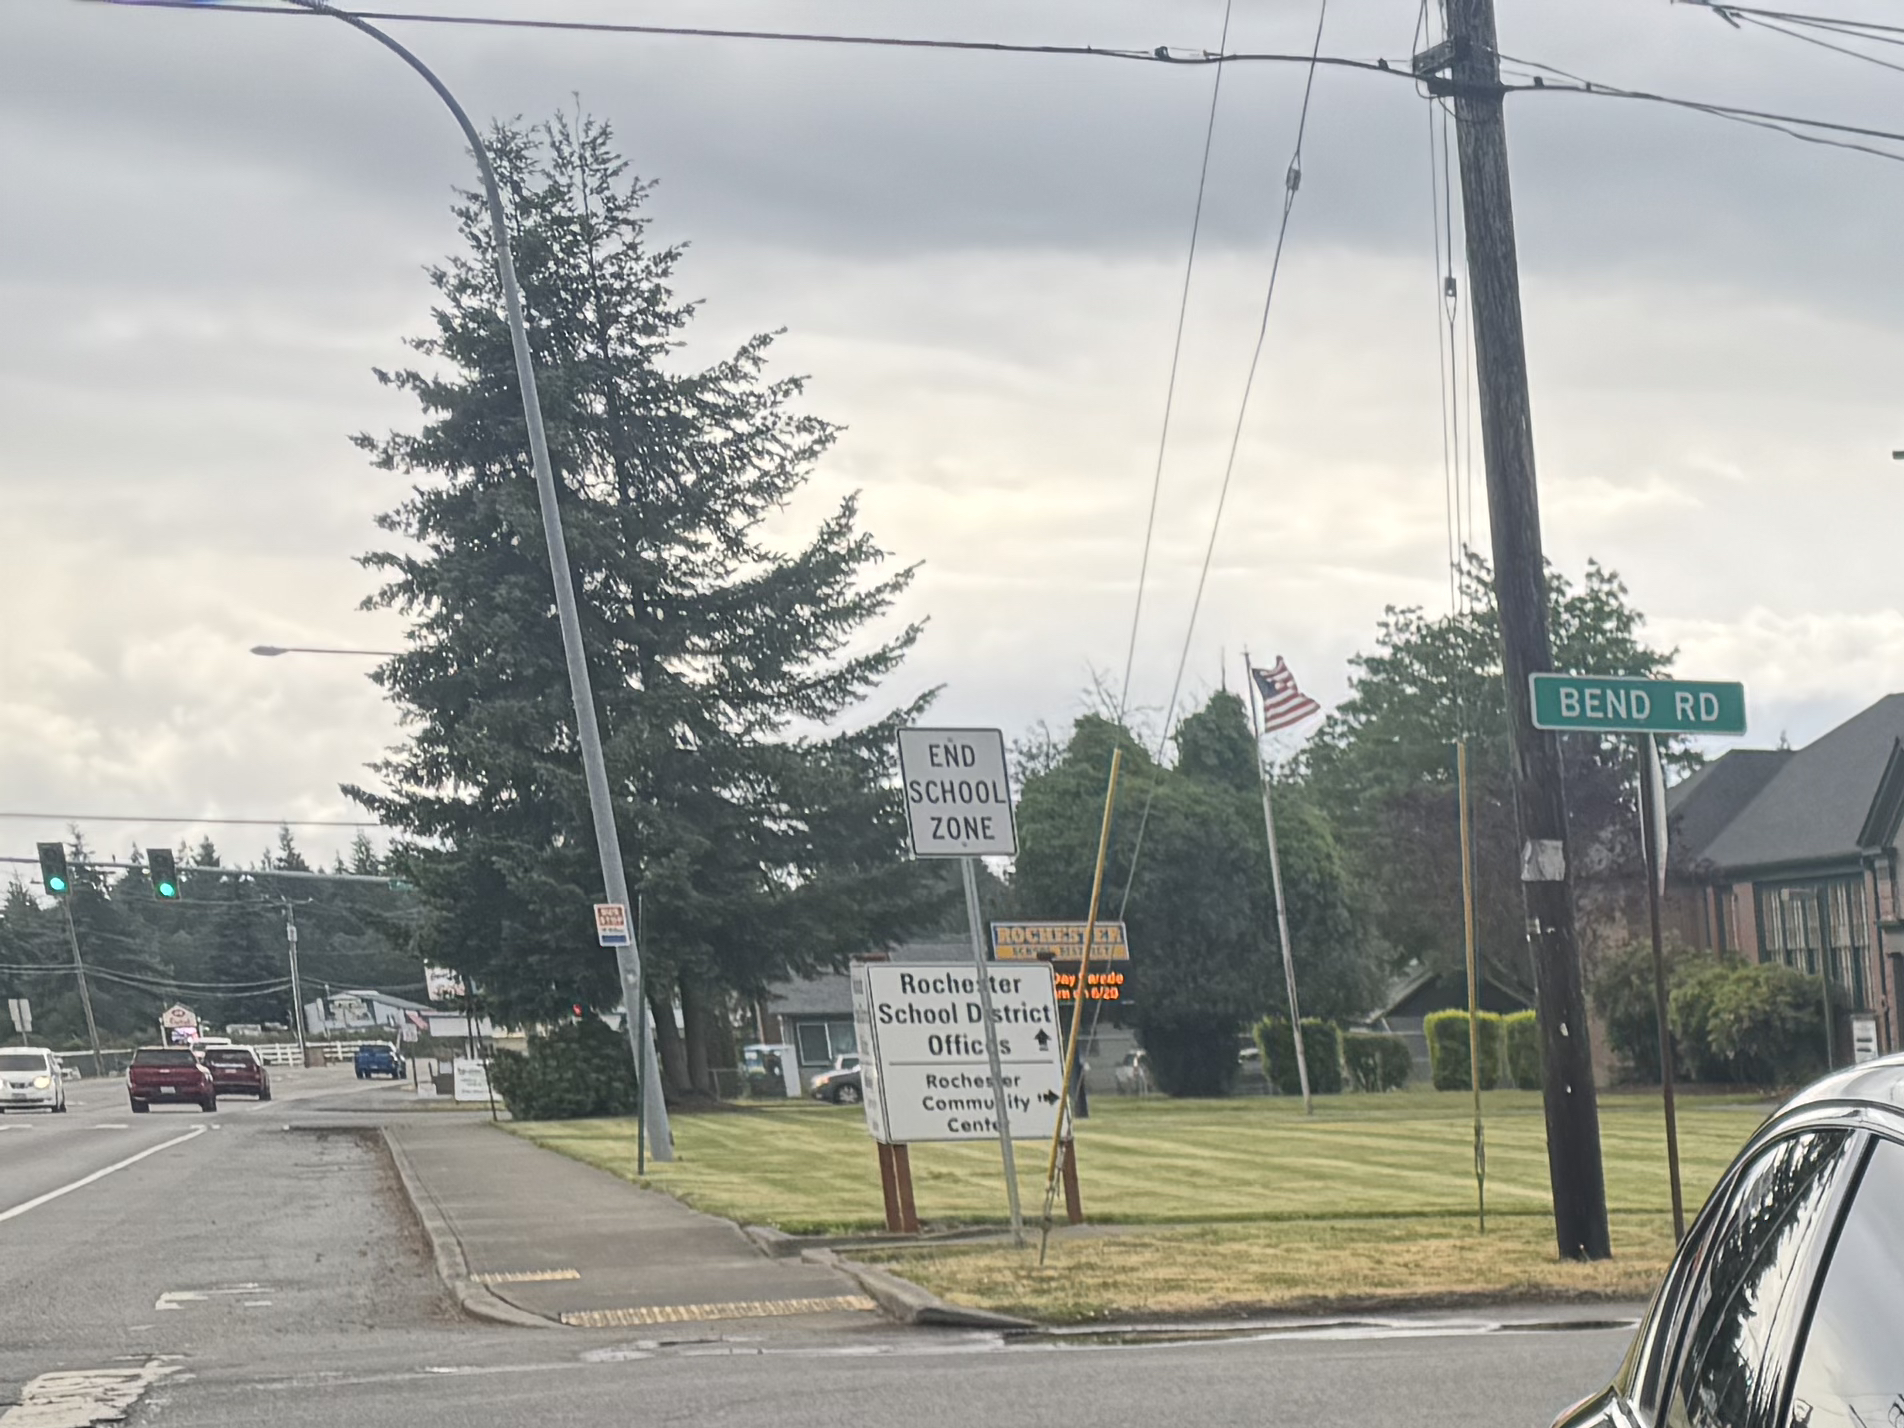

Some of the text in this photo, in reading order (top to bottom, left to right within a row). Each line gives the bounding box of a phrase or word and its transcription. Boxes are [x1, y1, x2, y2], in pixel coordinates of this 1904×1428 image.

[1560, 687, 1719, 722] BEND RD
[929, 744, 976, 768] END
[909, 780, 1006, 804] SCHOOL
[930, 816, 996, 840] ZONE
[996, 927, 1122, 944] ROCHESER
[900, 972, 1022, 994] Rocheter
[879, 1001, 1052, 1024] School Dstrict
[928, 1034, 1012, 1056] Offics
[922, 1096, 1030, 1113] Commuity
